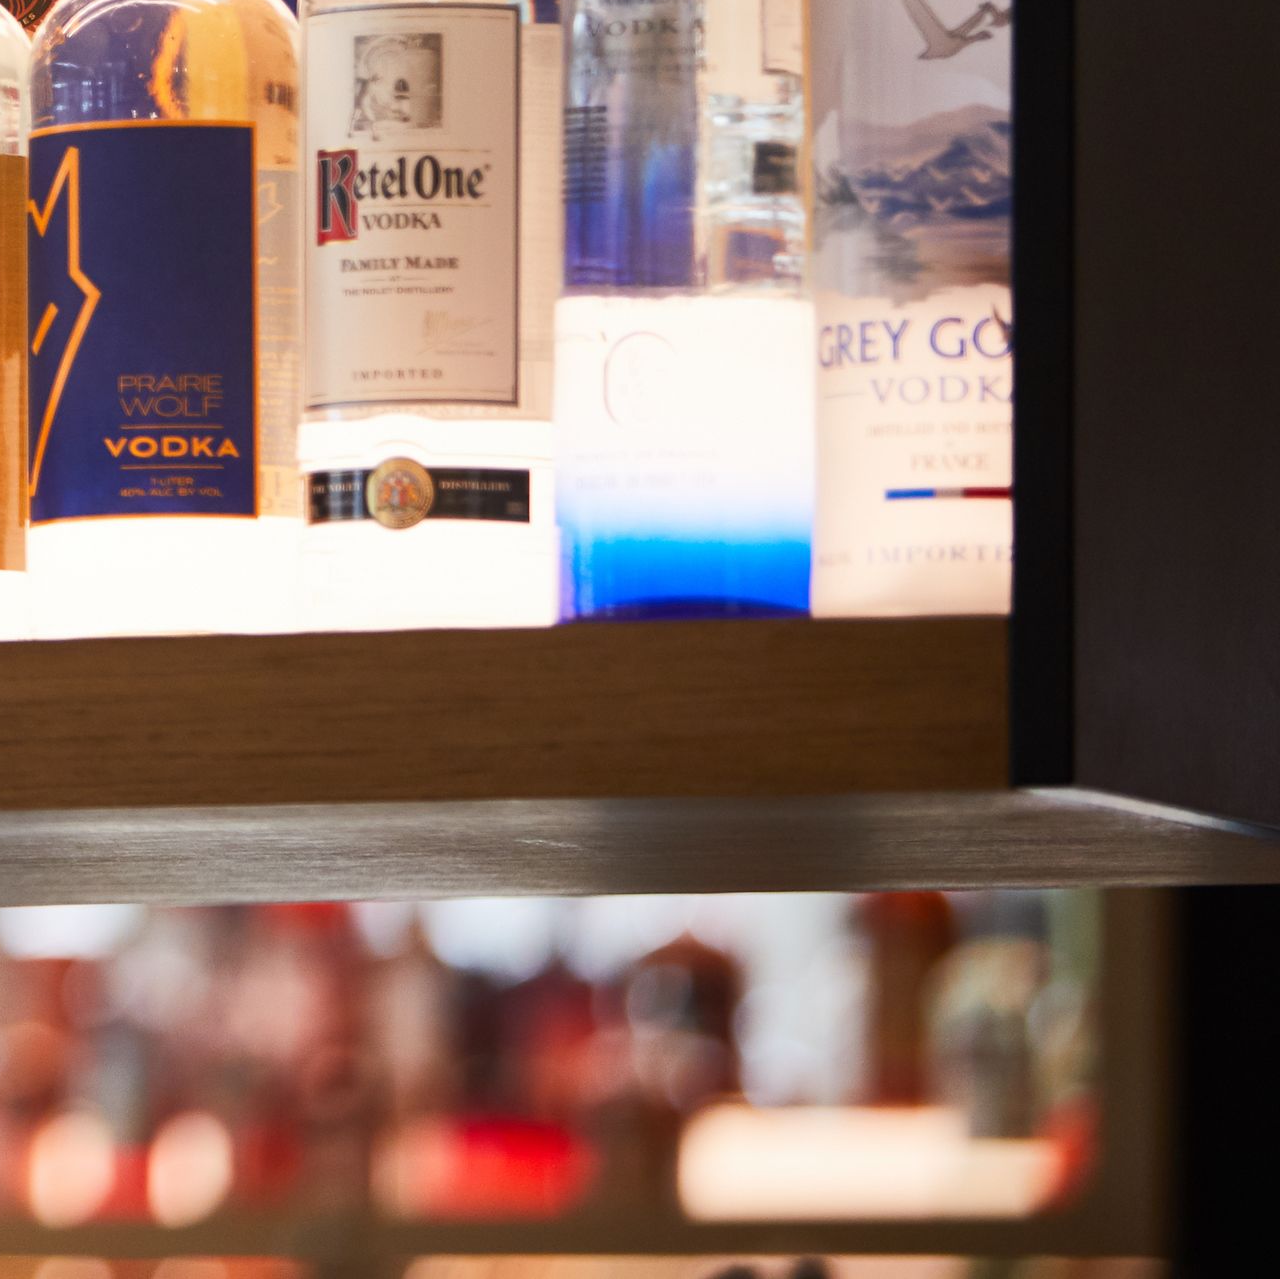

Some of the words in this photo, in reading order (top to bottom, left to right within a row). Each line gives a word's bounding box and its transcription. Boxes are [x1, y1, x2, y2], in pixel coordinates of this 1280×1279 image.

[318, 155, 407, 237] Ketel
[414, 153, 484, 200] One
[361, 212, 443, 231] VODKA
[818, 317, 909, 369] GREY
[118, 374, 224, 394] PRAIRIE
[353, 368, 444, 382] IMPORTED
[869, 374, 1012, 406] VODK
[120, 396, 223, 418] WOLF
[103, 436, 240, 459] VODKA
[910, 453, 989, 471] FRANCE
